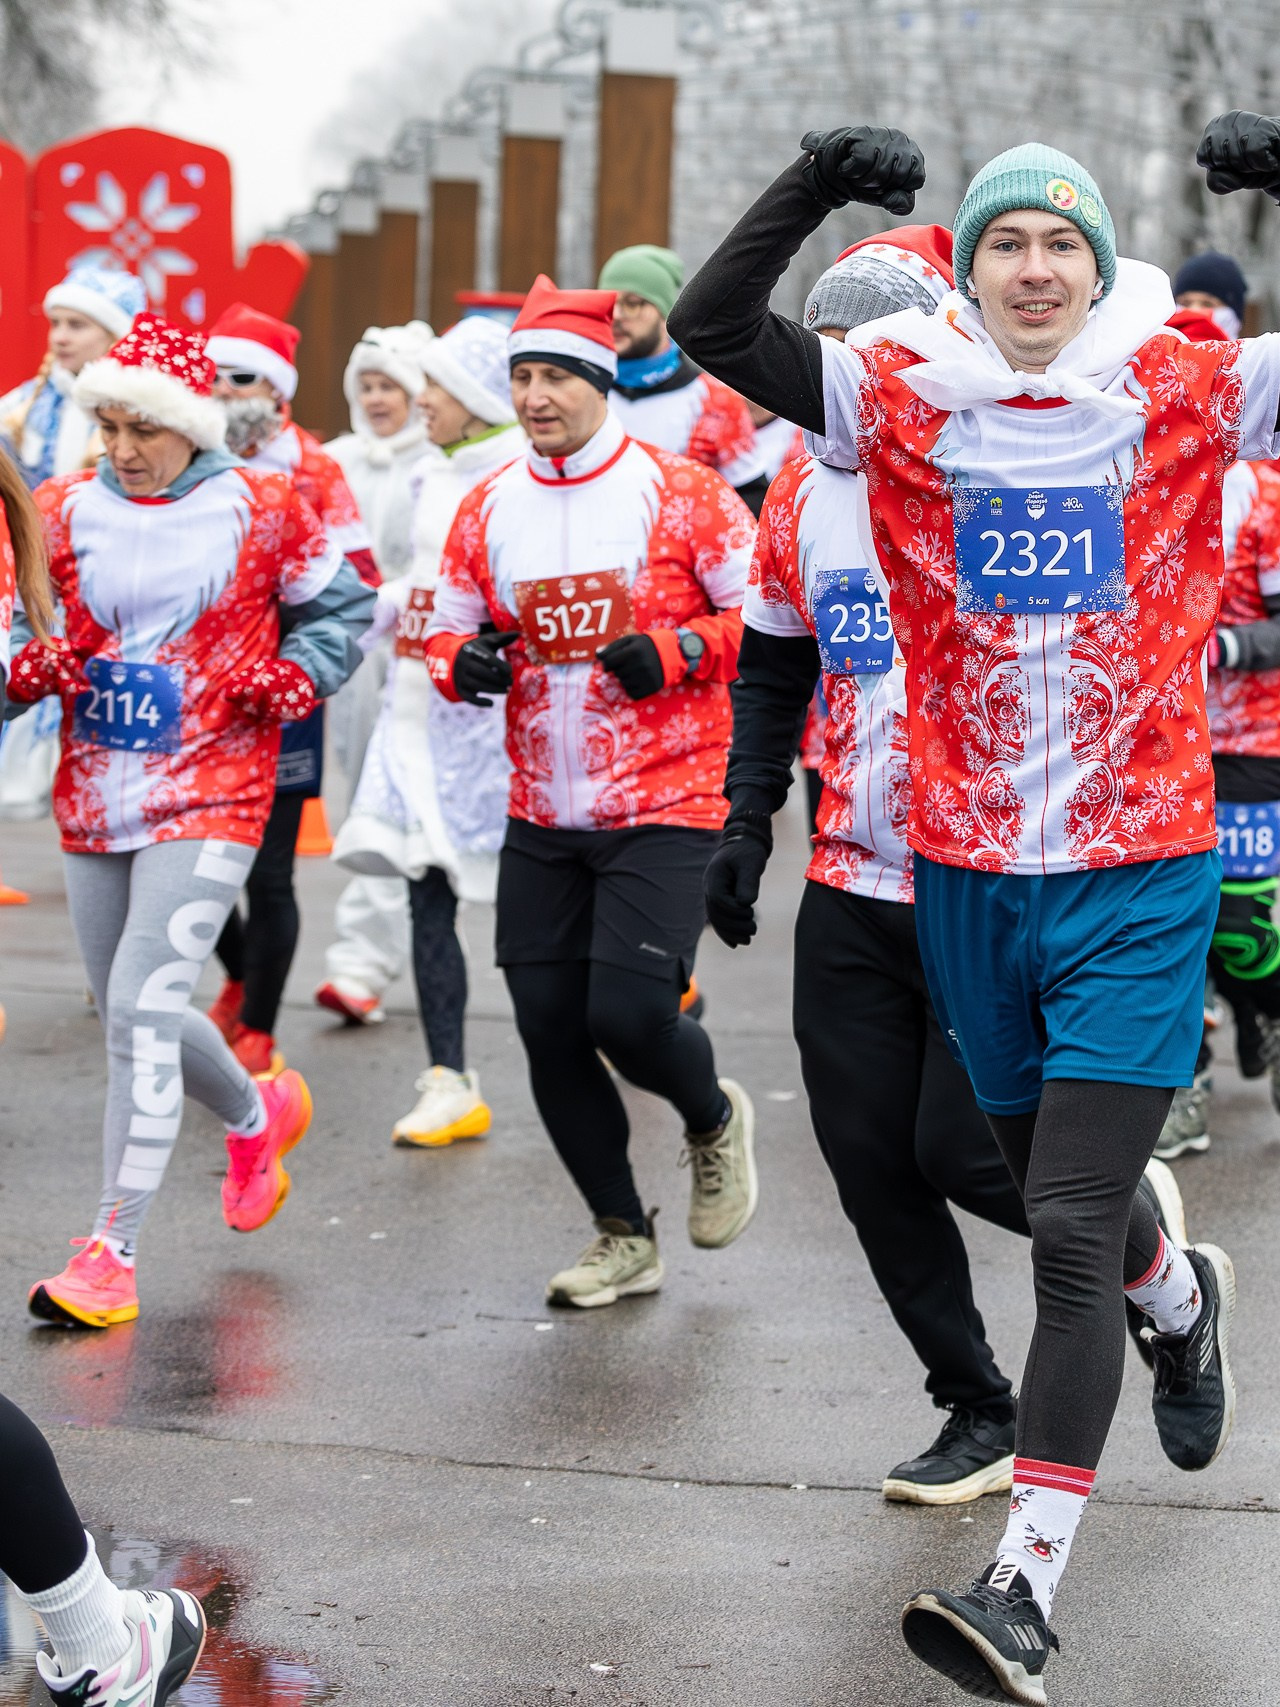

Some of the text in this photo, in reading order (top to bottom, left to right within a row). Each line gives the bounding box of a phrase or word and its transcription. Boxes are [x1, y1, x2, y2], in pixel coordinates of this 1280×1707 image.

[979, 529, 1093, 577] 2321
[535, 598, 613, 642] 5127
[1028, 596, 1034, 605] 5
[829, 603, 894, 643] 235
[84, 685, 162, 728] 2114
